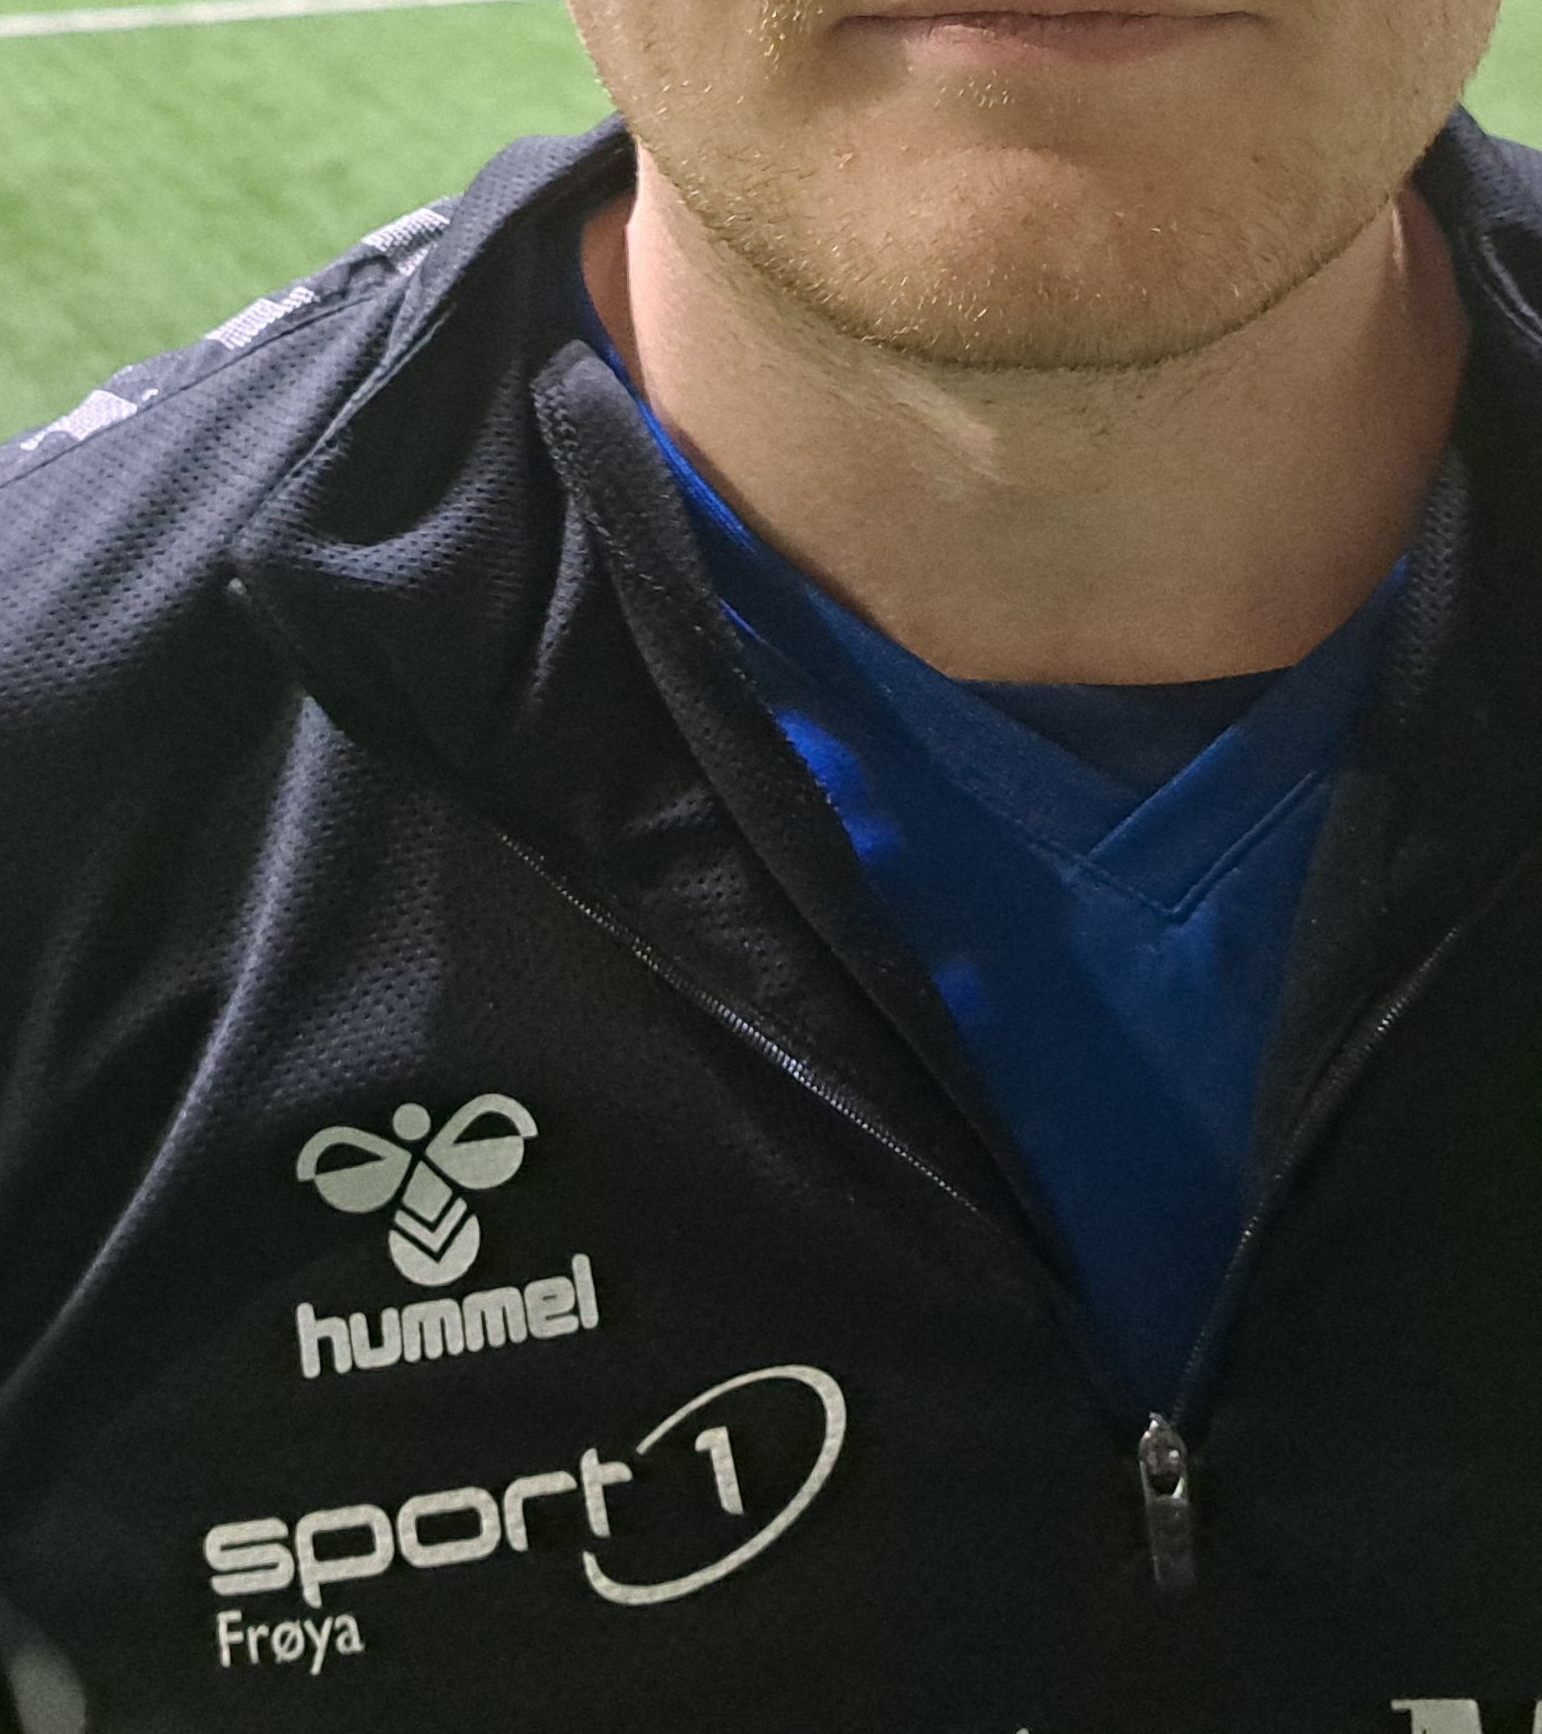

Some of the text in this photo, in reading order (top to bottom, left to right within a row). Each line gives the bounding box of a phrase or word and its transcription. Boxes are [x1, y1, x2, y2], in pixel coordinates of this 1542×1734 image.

[295, 1253, 599, 1379] hummel
[203, 1426, 744, 1608] sport 1
[216, 1609, 365, 1676] Frøya
